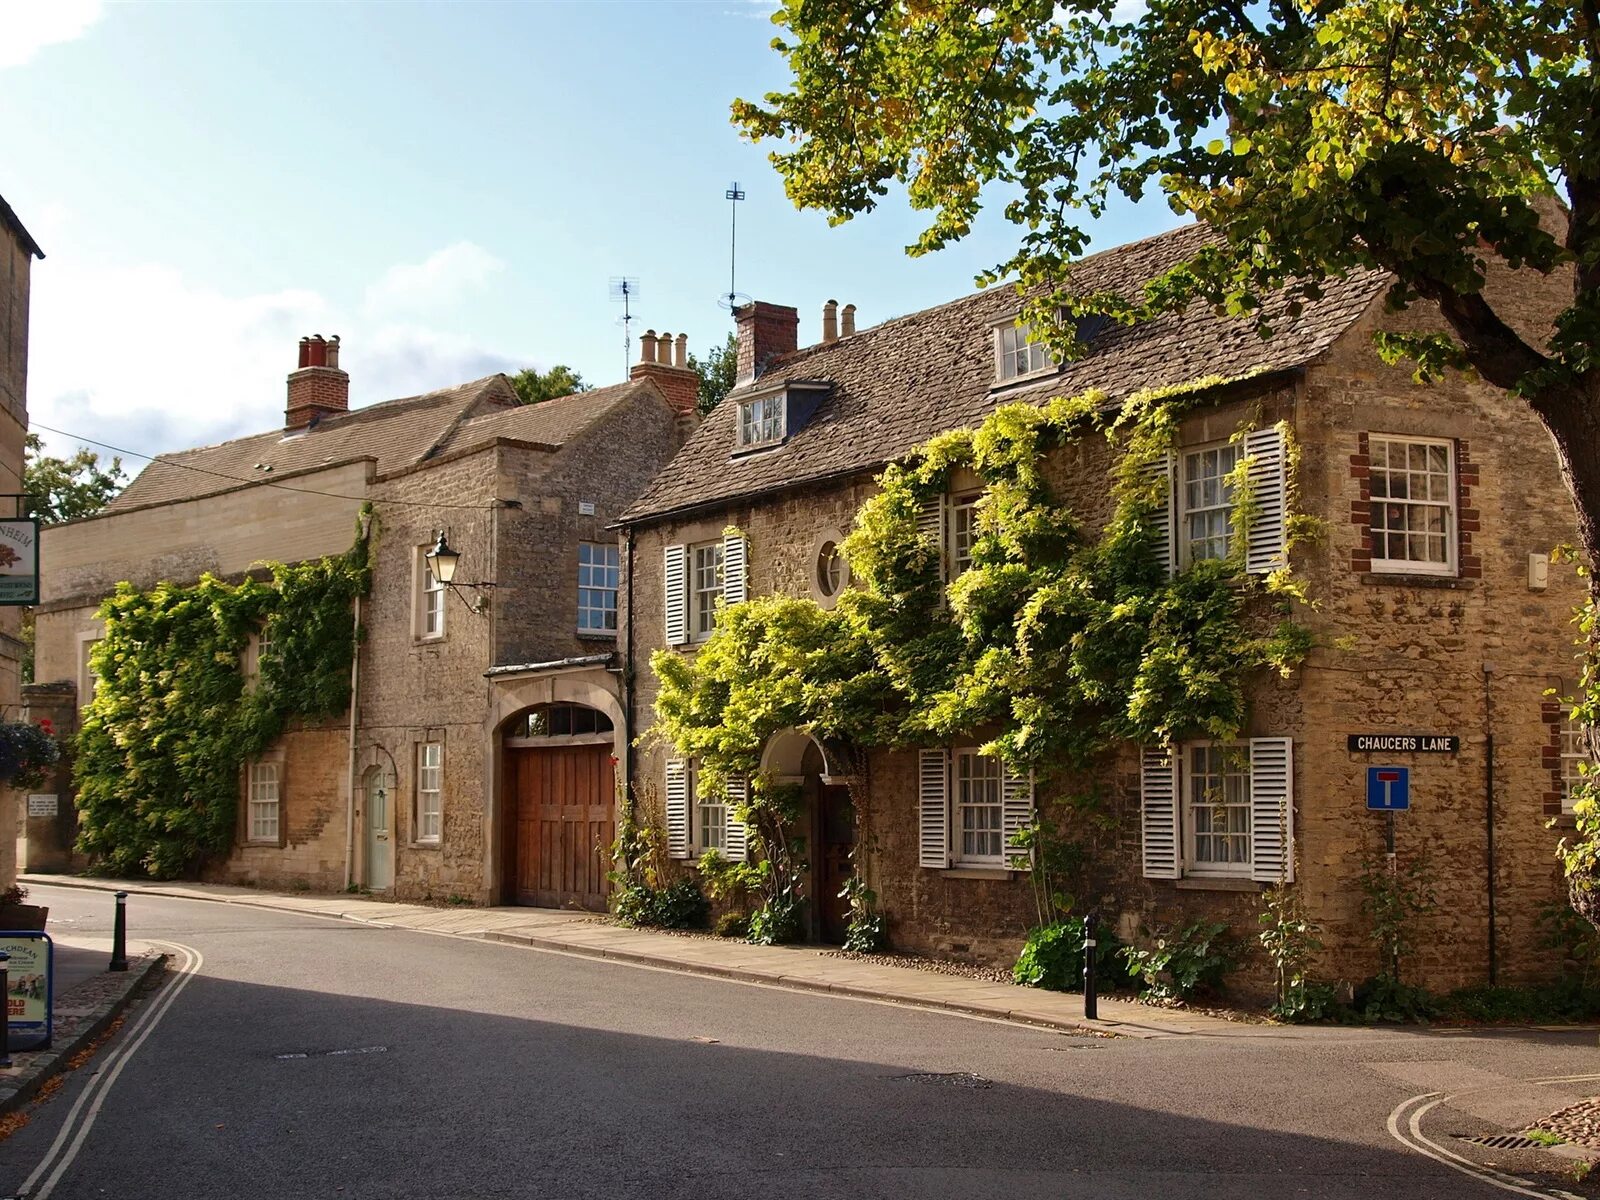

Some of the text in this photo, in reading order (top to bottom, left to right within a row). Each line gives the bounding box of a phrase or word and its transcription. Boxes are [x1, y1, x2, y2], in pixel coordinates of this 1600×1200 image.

[1358, 737, 1451, 751] CHAUCER'S LANE
[7, 999, 25, 1007] OLD
[7, 1008, 25, 1016] ERE
